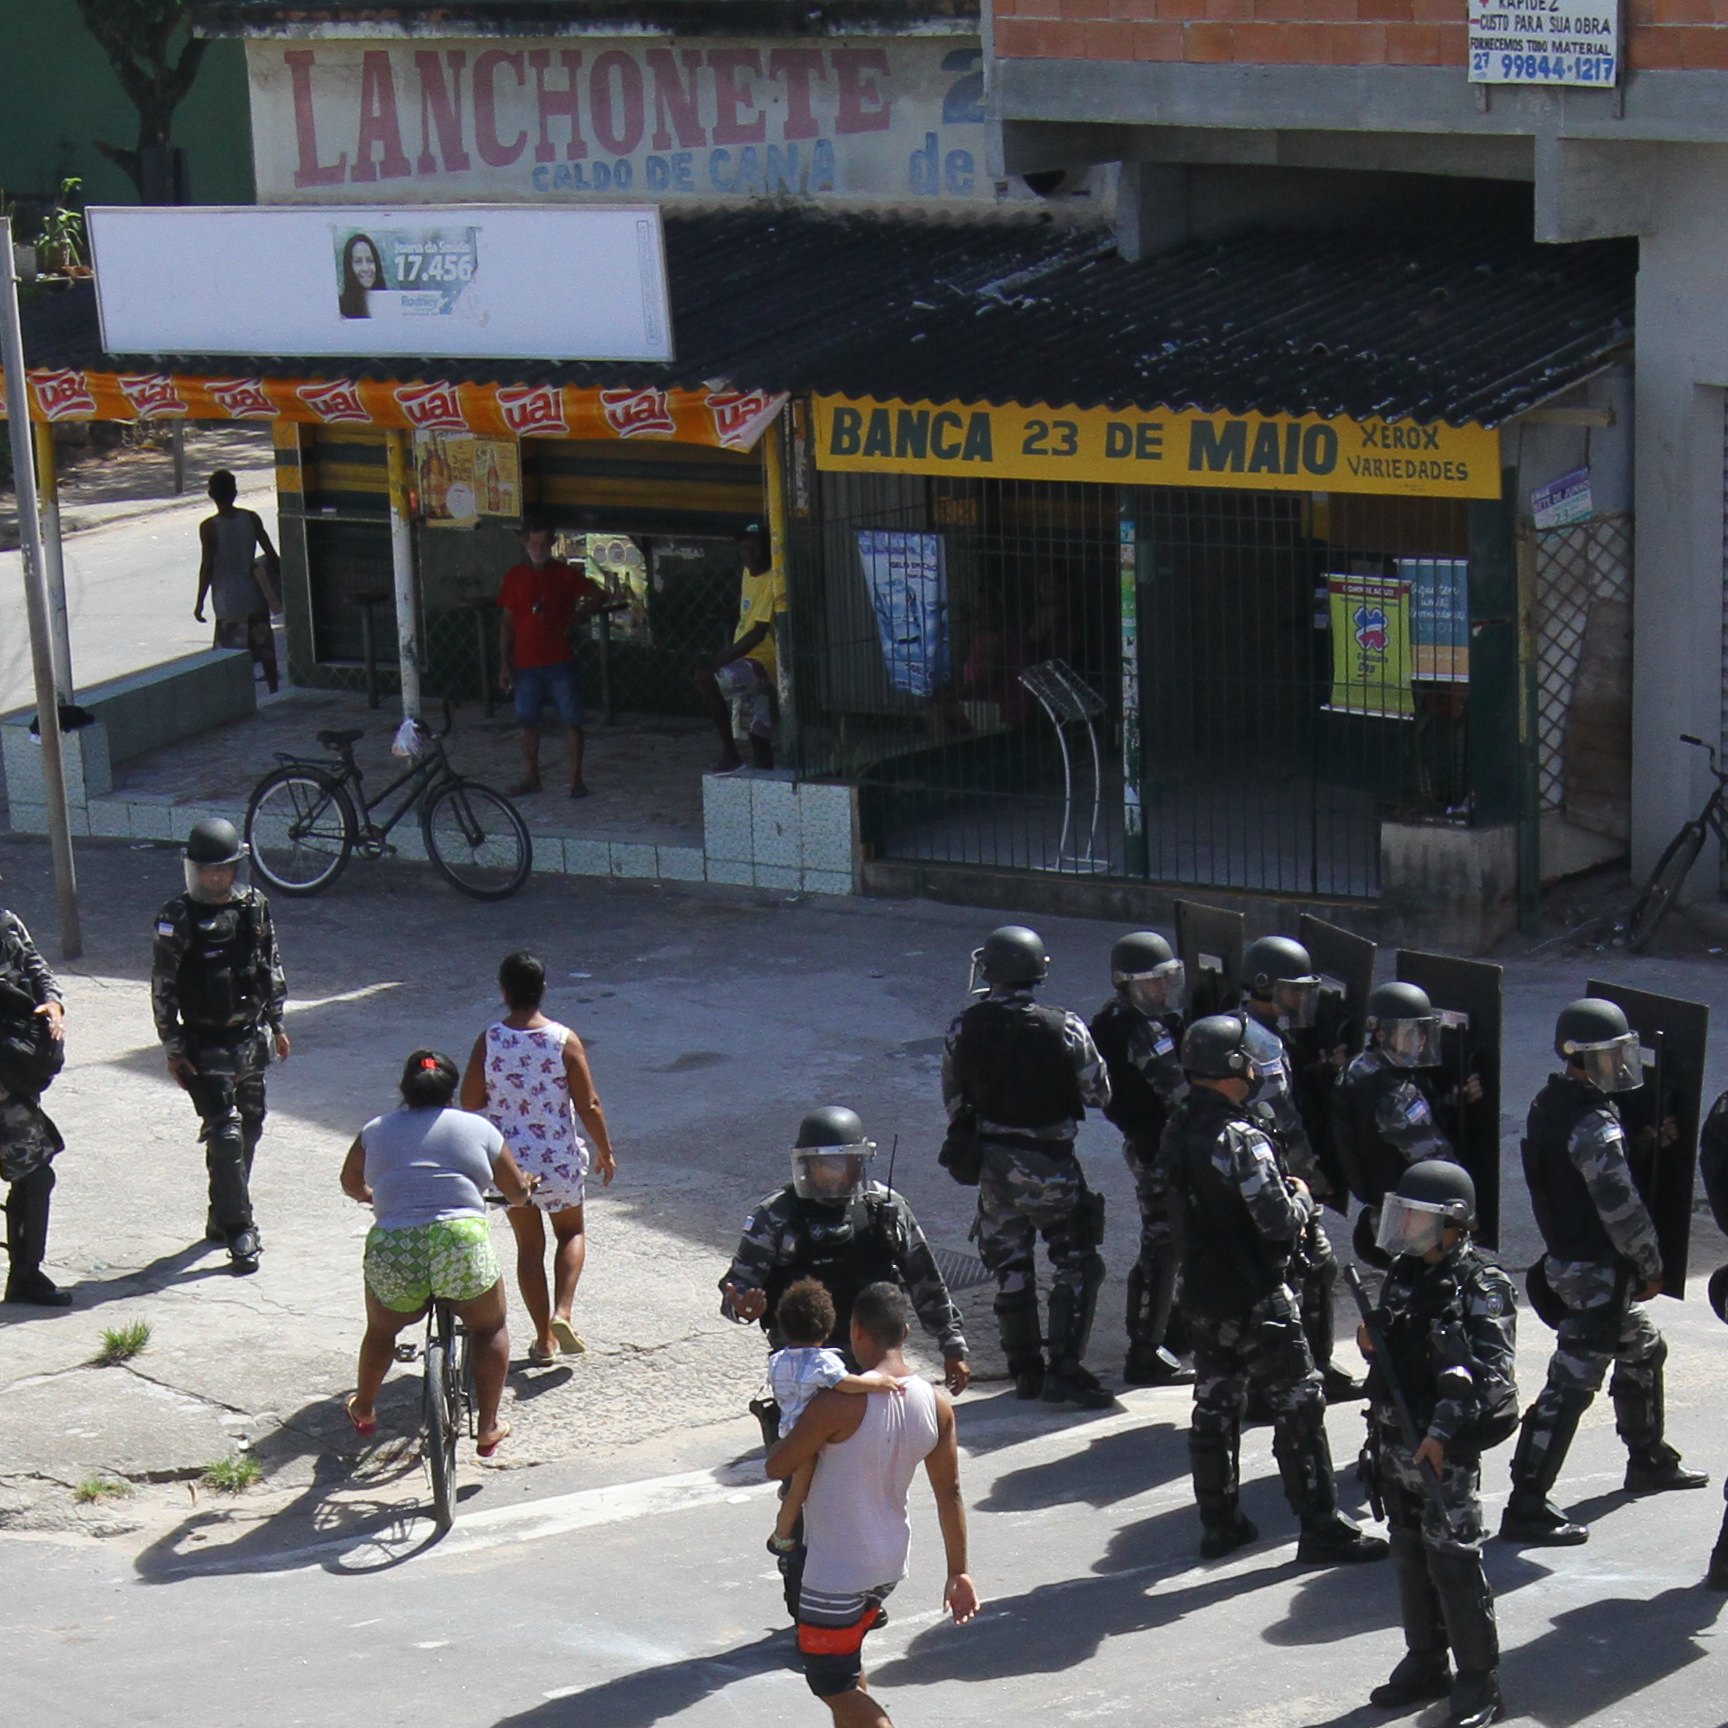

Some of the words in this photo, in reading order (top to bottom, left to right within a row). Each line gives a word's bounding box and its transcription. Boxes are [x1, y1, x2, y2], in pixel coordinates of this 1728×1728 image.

[1480, 14, 1509, 31] CUSTO
[1514, 15, 1543, 32] PARA
[1549, 16, 1570, 33] SUA
[1575, 17, 1611, 35] OBRA
[1470, 36, 1522, 51] FORNECEMOS
[1526, 39, 1548, 52] TODO
[1552, 40, 1611, 56] MATERIAL
[1474, 52, 1490, 70] 27
[284, 49, 891, 188] LANCHONETE
[532, 158, 633, 191] CALDO
[646, 153, 693, 192] DE
[709, 138, 835, 193] CANA
[909, 132, 975, 195] de
[394, 254, 473, 281] 17.456
[830, 407, 993, 462] BANCA
[1022, 419, 1079, 456] 23
[1105, 421, 1163, 460] DE
[1188, 419, 1338, 476] MAIO
[1360, 423, 1439, 450] XEROX
[1347, 455, 1469, 481] VARIEDADES
